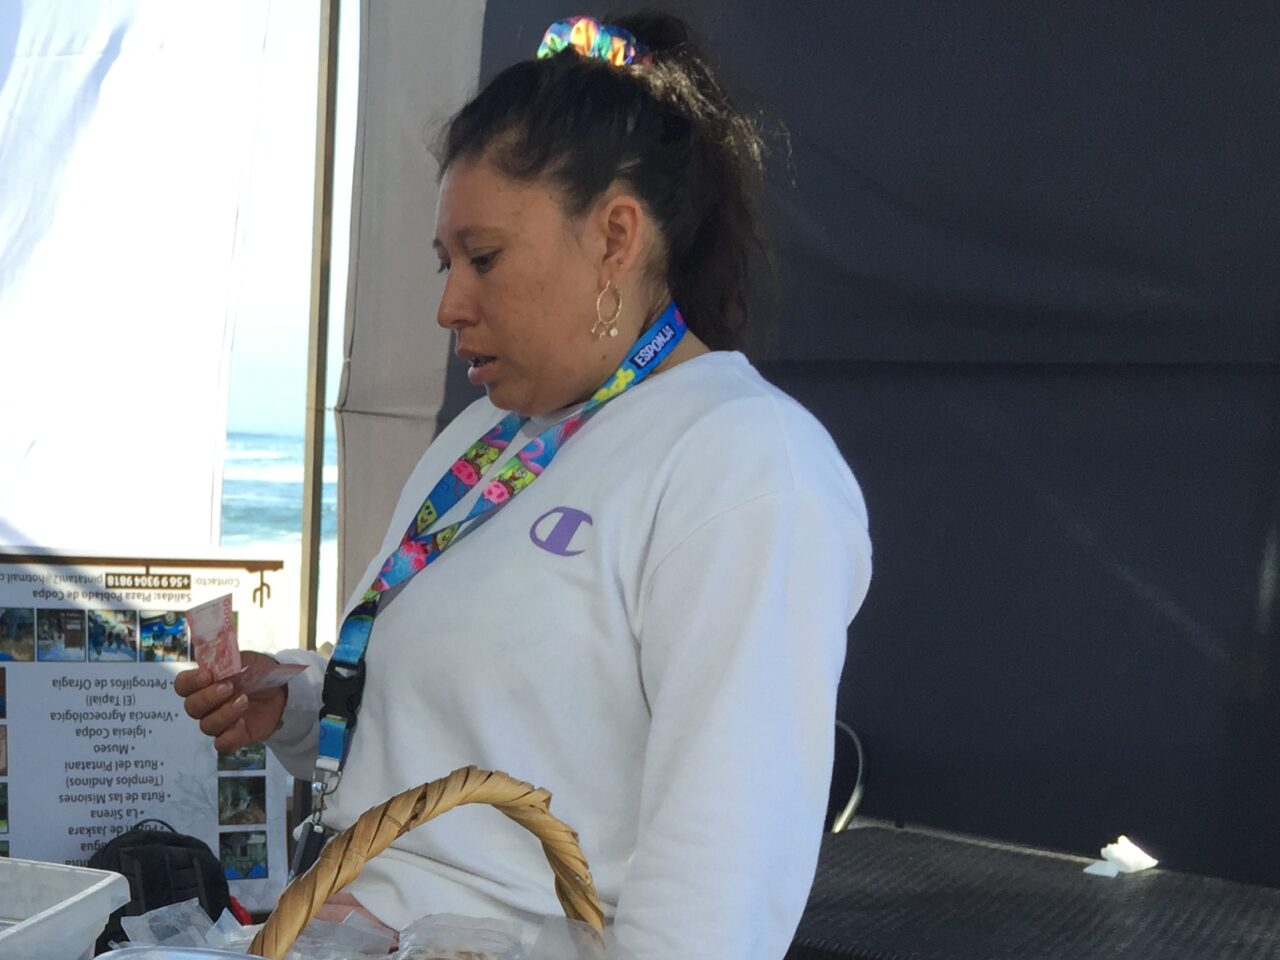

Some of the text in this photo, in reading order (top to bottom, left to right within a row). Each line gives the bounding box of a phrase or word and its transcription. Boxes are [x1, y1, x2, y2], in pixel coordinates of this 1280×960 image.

[633, 324, 675, 367] ESPONJA
[193, 577, 240, 588] Contacto:
[33, 588, 192, 602] Salidas: Plaza Poblado de Codpa
[52, 676, 167, 690] Petroglifos de Ofragia
[85, 694, 136, 706] (El Tapial)
[50, 710, 173, 723] Vivencia Agroecológica
[75, 725, 146, 739] Iglesia Codpa
[93, 744, 128, 754] Museo
[64, 760, 158, 772] Ruta del Pintatani
[66, 774, 163, 788] (Templos Andinos)
[58, 792, 165, 804] Ruta de las Misiones
[90, 808, 138, 820] La Sirena
[68, 825, 107, 837] Jaskara
[110, 825, 123, 835] de
